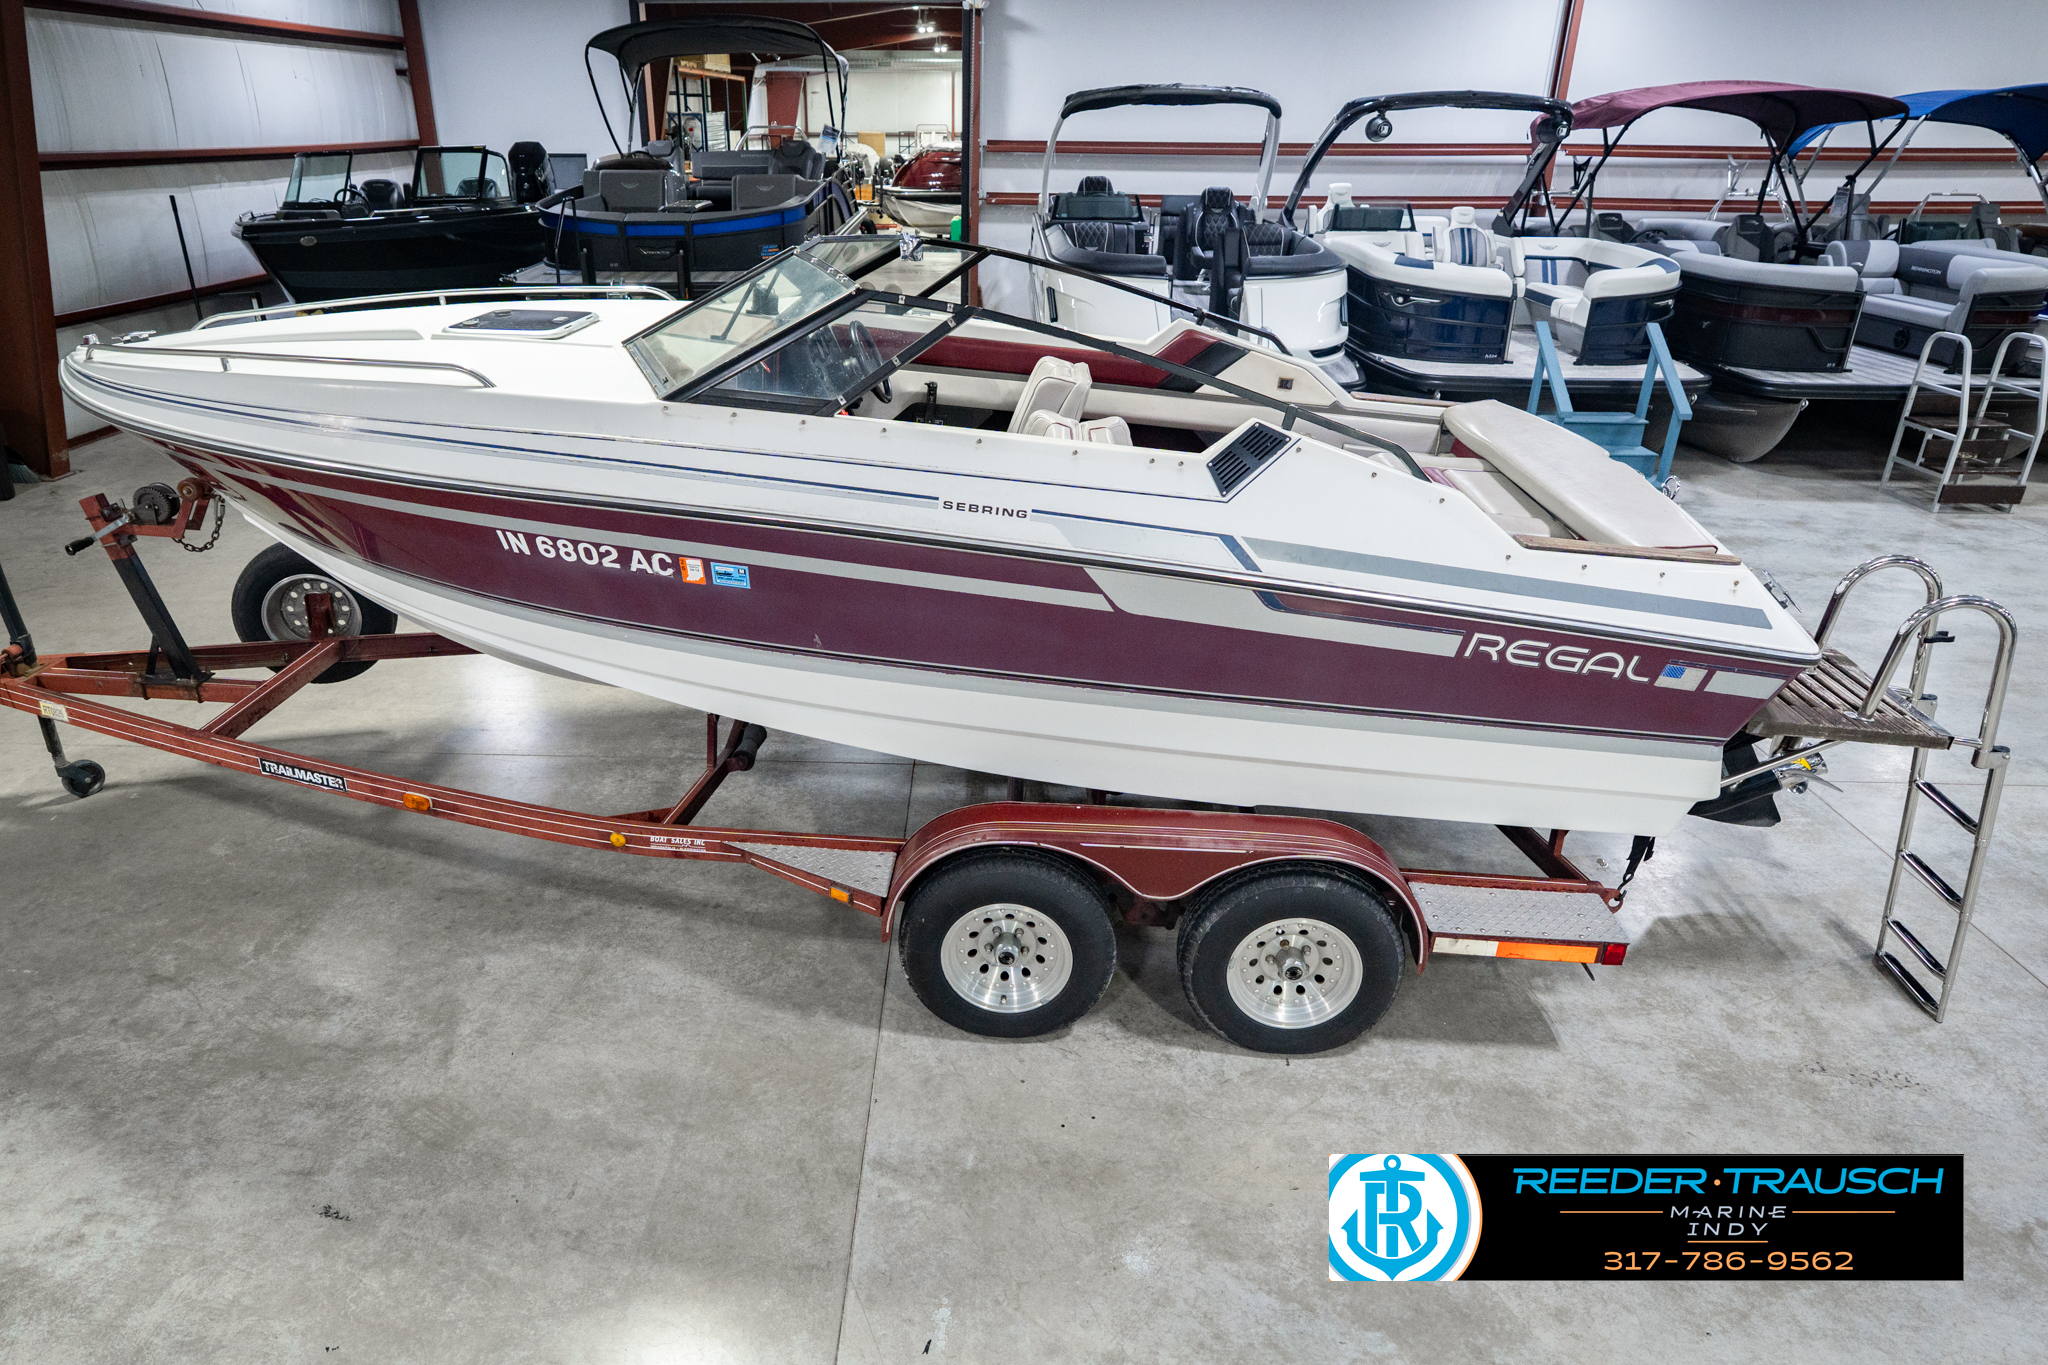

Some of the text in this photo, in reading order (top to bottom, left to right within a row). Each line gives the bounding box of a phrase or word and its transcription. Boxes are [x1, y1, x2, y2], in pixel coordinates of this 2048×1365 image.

[942, 500, 1028, 518] SEBRING
[496, 530, 674, 576] IN 6802 AC
[1463, 632, 1650, 683] REGAL
[262, 761, 344, 789] TRAILMASTER
[671, 837, 691, 845] SALES
